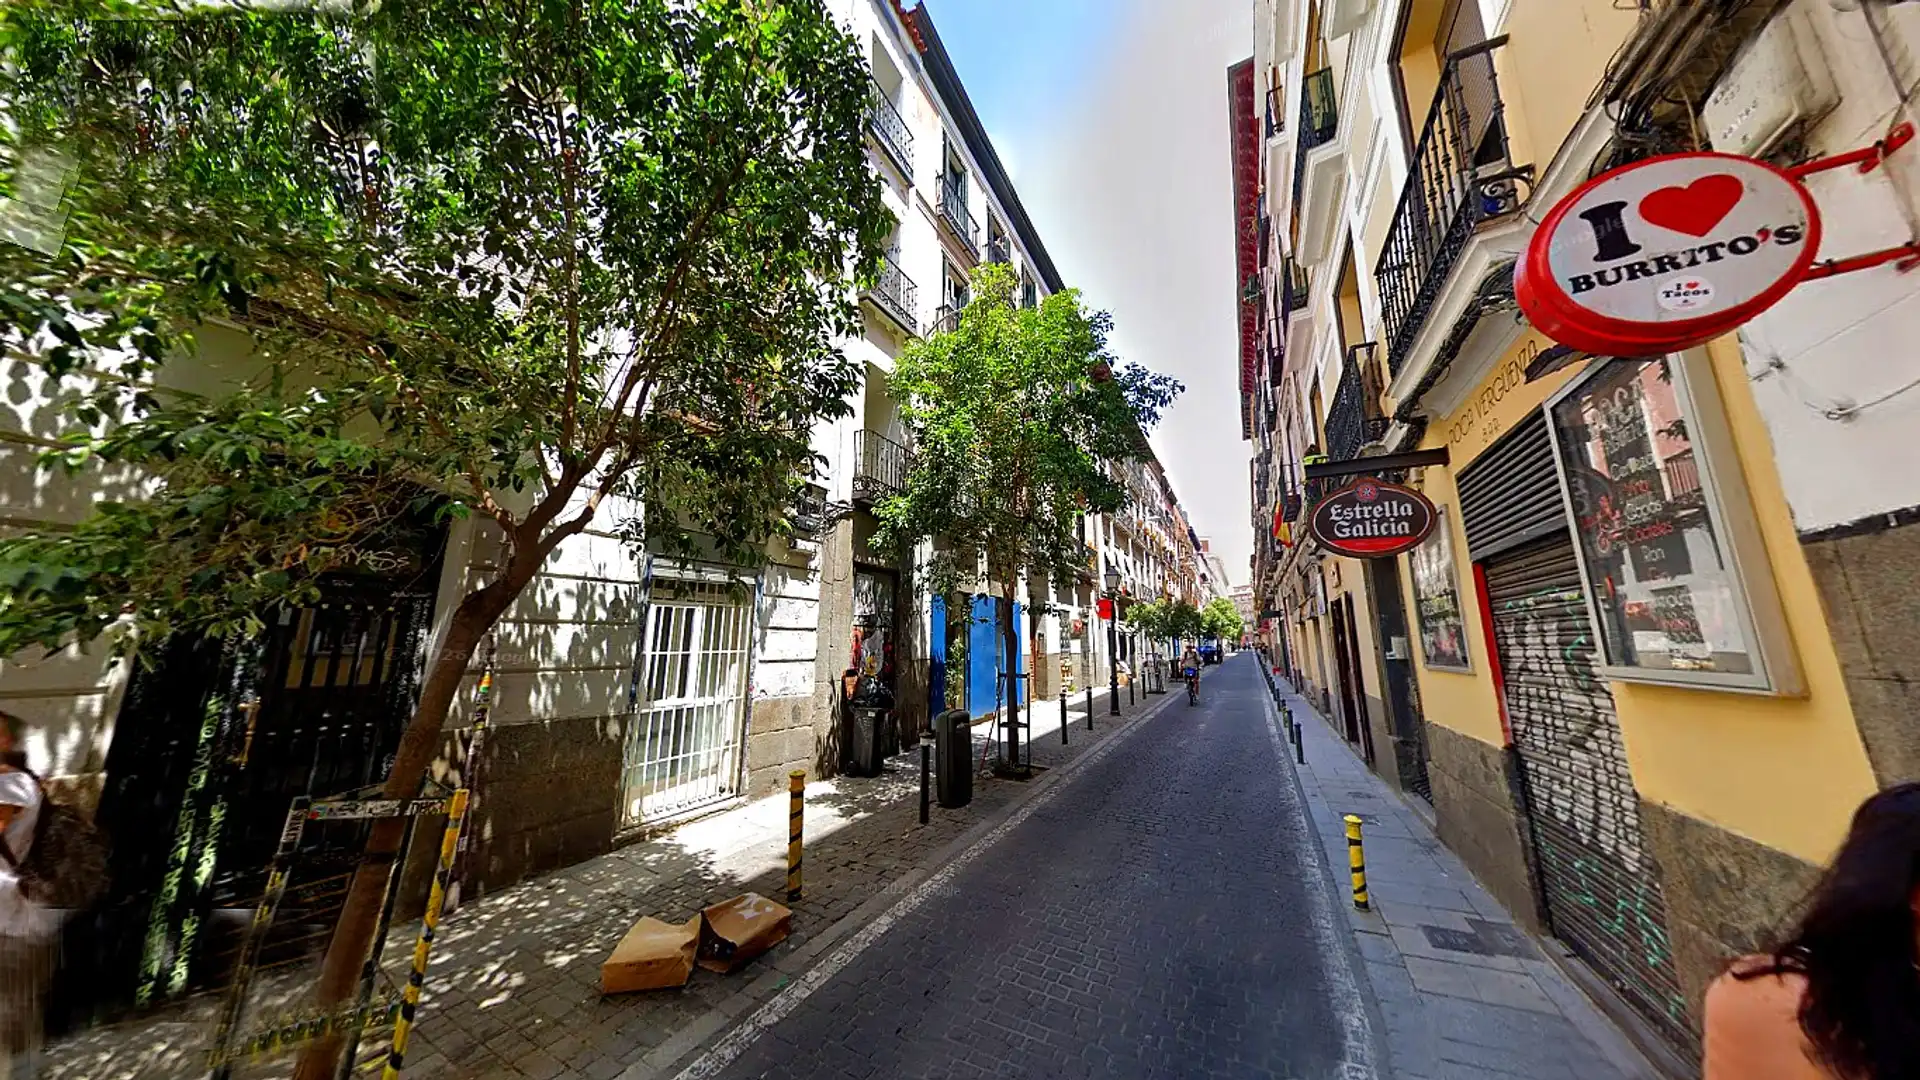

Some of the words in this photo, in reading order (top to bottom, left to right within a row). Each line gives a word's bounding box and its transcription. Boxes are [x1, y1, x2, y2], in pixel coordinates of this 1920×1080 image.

[1579, 200, 1642, 262] I
[1568, 224, 1803, 295] BURRITO'S
[1662, 288, 1710, 299] Tacos
[1329, 500, 1414, 521] Estrella
[1334, 517, 1410, 538] Galicia
